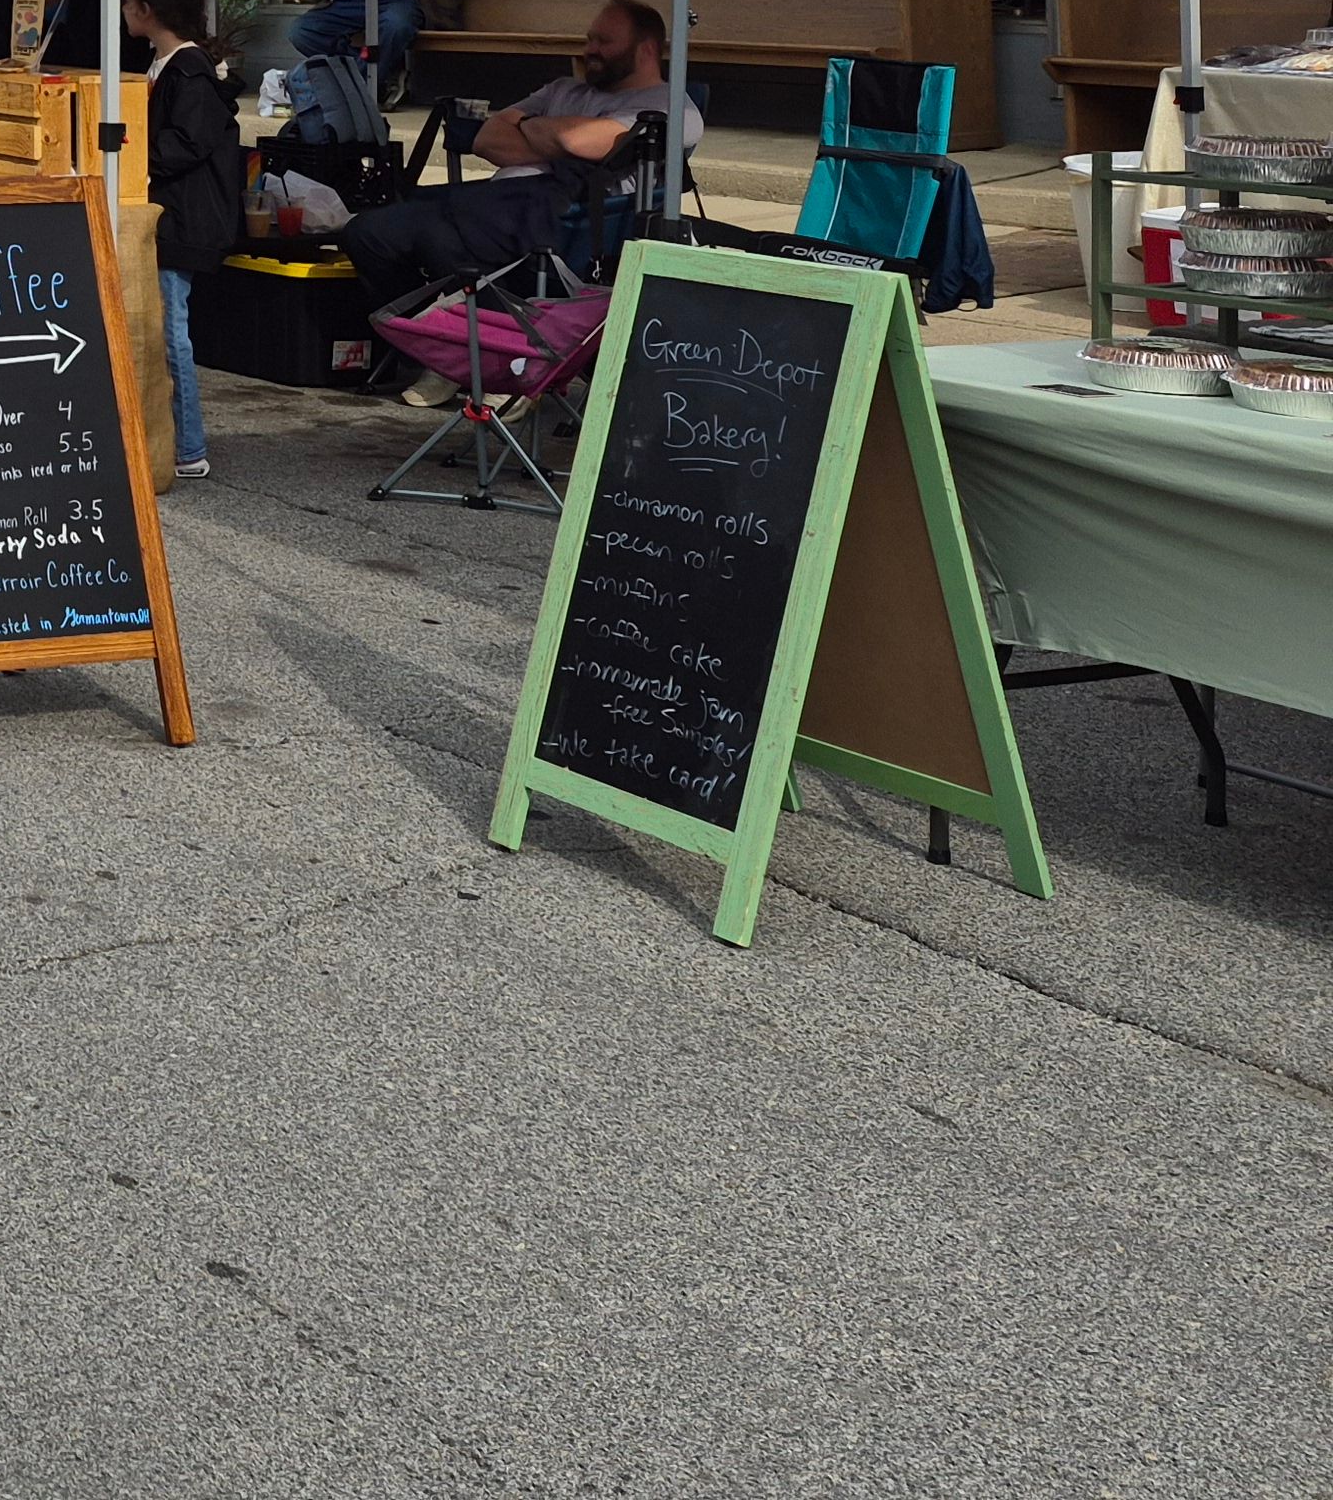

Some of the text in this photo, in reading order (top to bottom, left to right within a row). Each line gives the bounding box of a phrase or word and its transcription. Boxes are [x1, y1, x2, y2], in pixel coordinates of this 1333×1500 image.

[642, 318, 825, 396] Green Depot
[58, 400, 73, 421] 4
[59, 430, 94, 453] 5.5
[662, 391, 788, 478] Bakery!
[30, 461, 54, 478] iced
[60, 463, 73, 474] or
[78, 455, 99, 473] hot
[23, 505, 49, 527] Roll
[67, 498, 104, 522] 3.5
[715, 511, 770, 545] rolls
[33, 523, 82, 550] Soda
[91, 525, 105, 544] 4
[46, 559, 104, 588] Coffee
[107, 558, 132, 584] Co.
[684, 546, 736, 580] rolls
[39, 616, 53, 632] in
[669, 642, 729, 682] cake
[695, 688, 745, 733] jam
[603, 738, 661, 780] take
